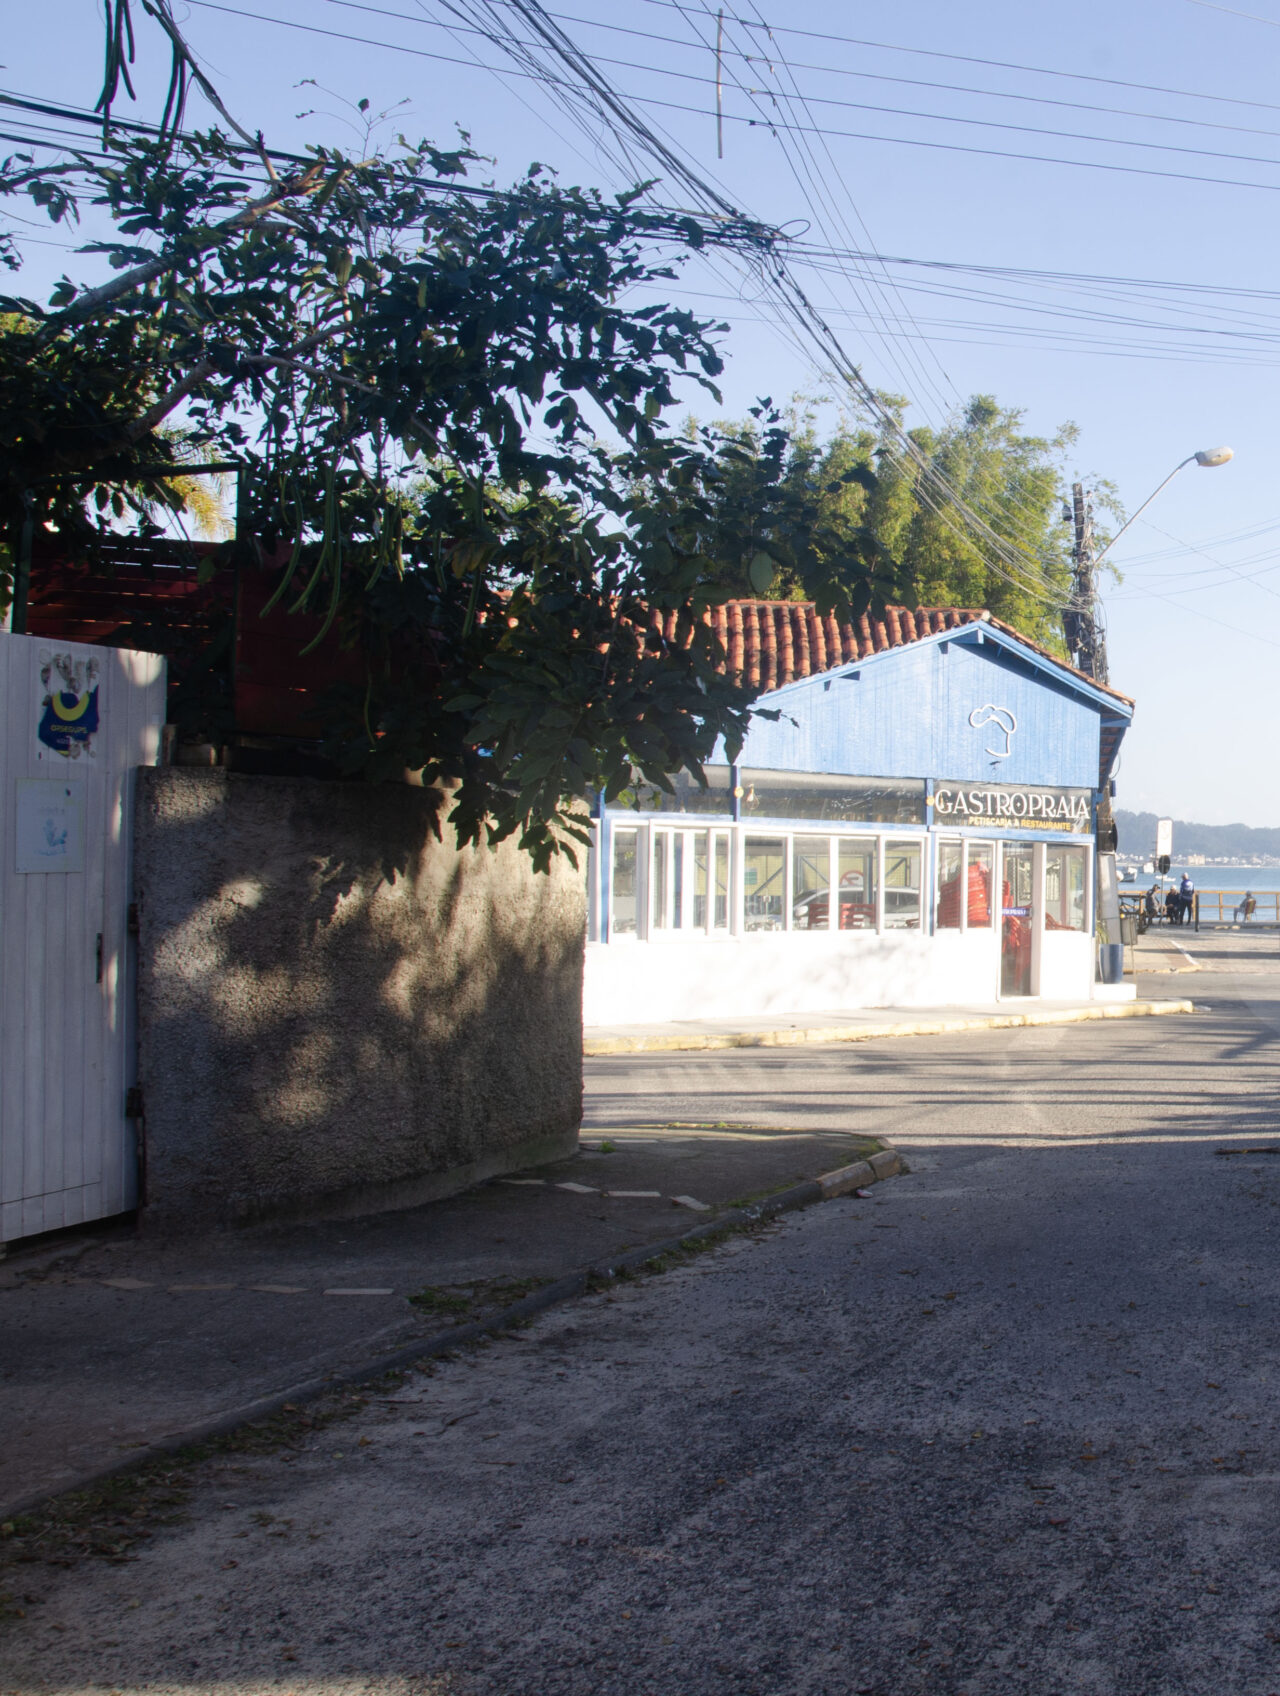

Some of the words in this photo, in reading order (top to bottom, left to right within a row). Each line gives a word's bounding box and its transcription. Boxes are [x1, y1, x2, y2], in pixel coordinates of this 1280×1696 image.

[935, 789, 1090, 820] GASTROPRAIA
[968, 816, 1012, 828] PETISCARIA
[1021, 820, 1071, 831] RESTAURANTE
